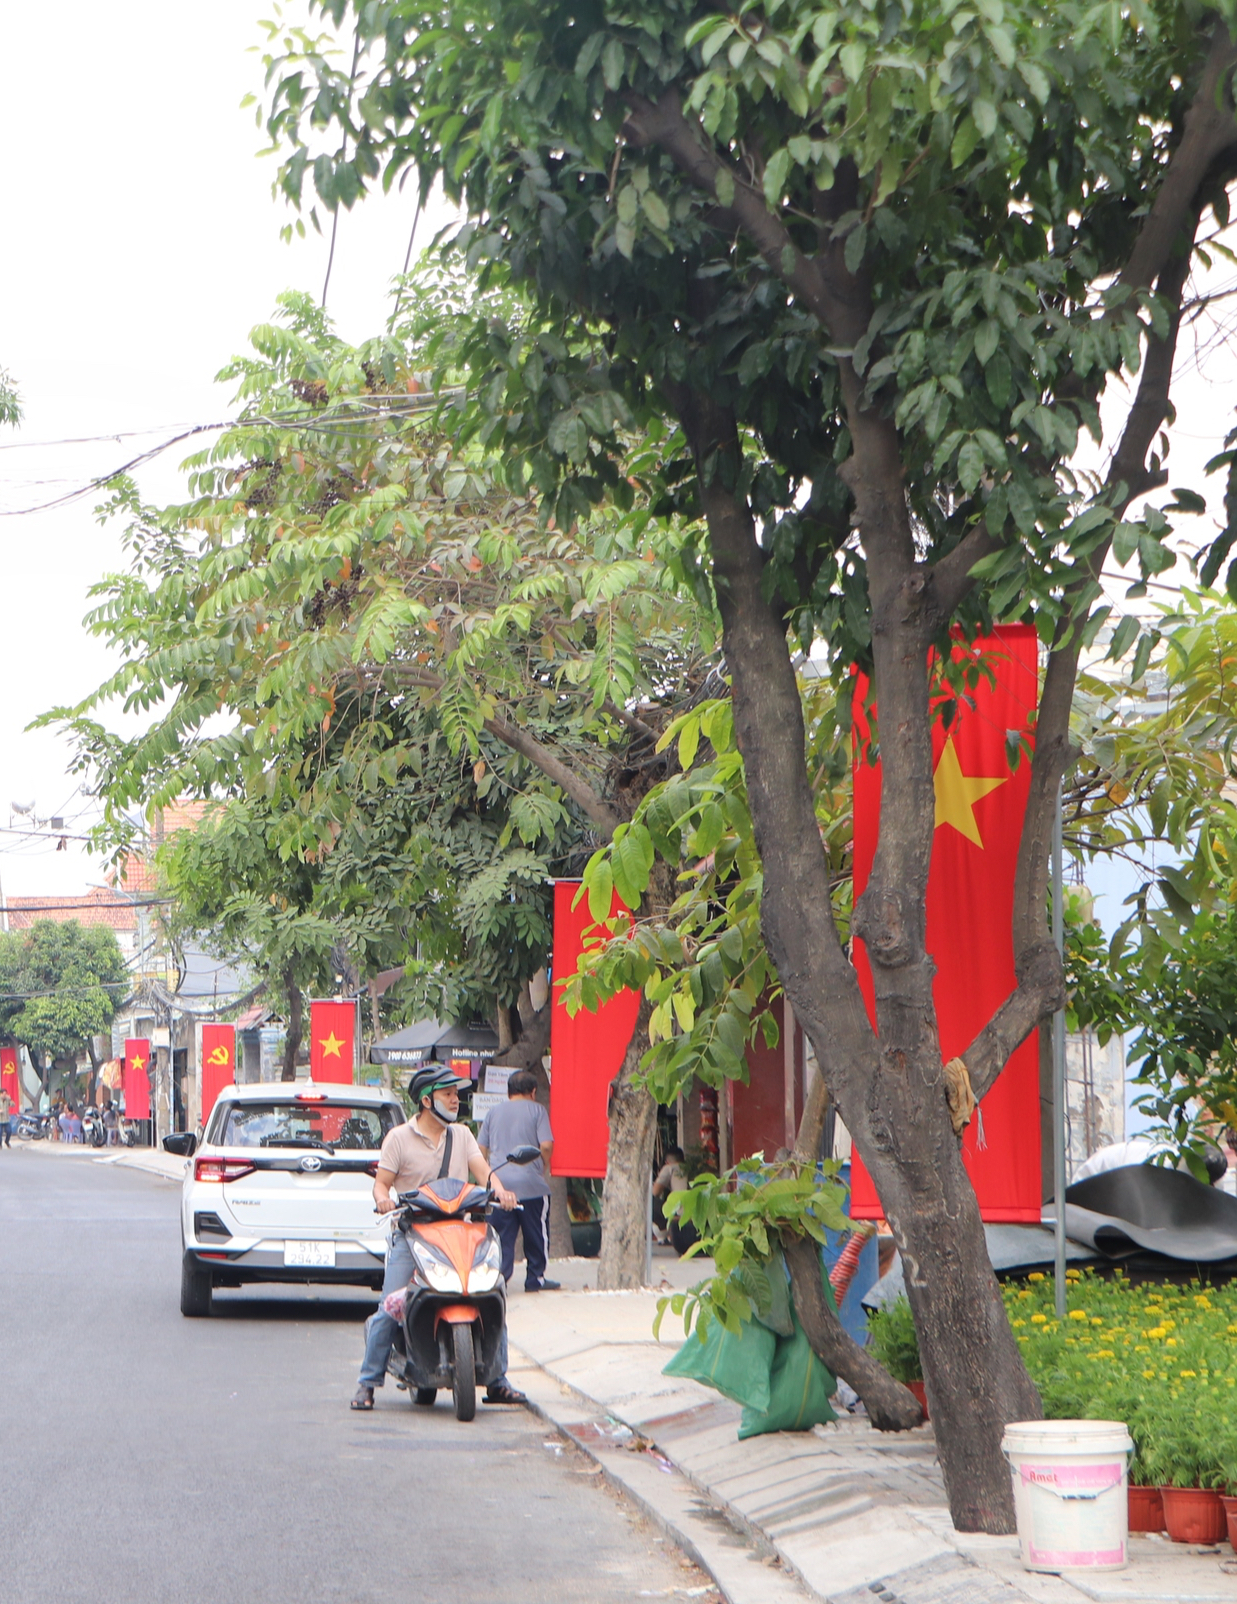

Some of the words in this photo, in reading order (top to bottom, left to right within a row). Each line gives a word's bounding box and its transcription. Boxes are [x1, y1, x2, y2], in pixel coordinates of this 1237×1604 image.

[452, 1048, 479, 1057] Hotline
[299, 1242, 320, 1253] 51K
[290, 1253, 330, 1264] 294.22
